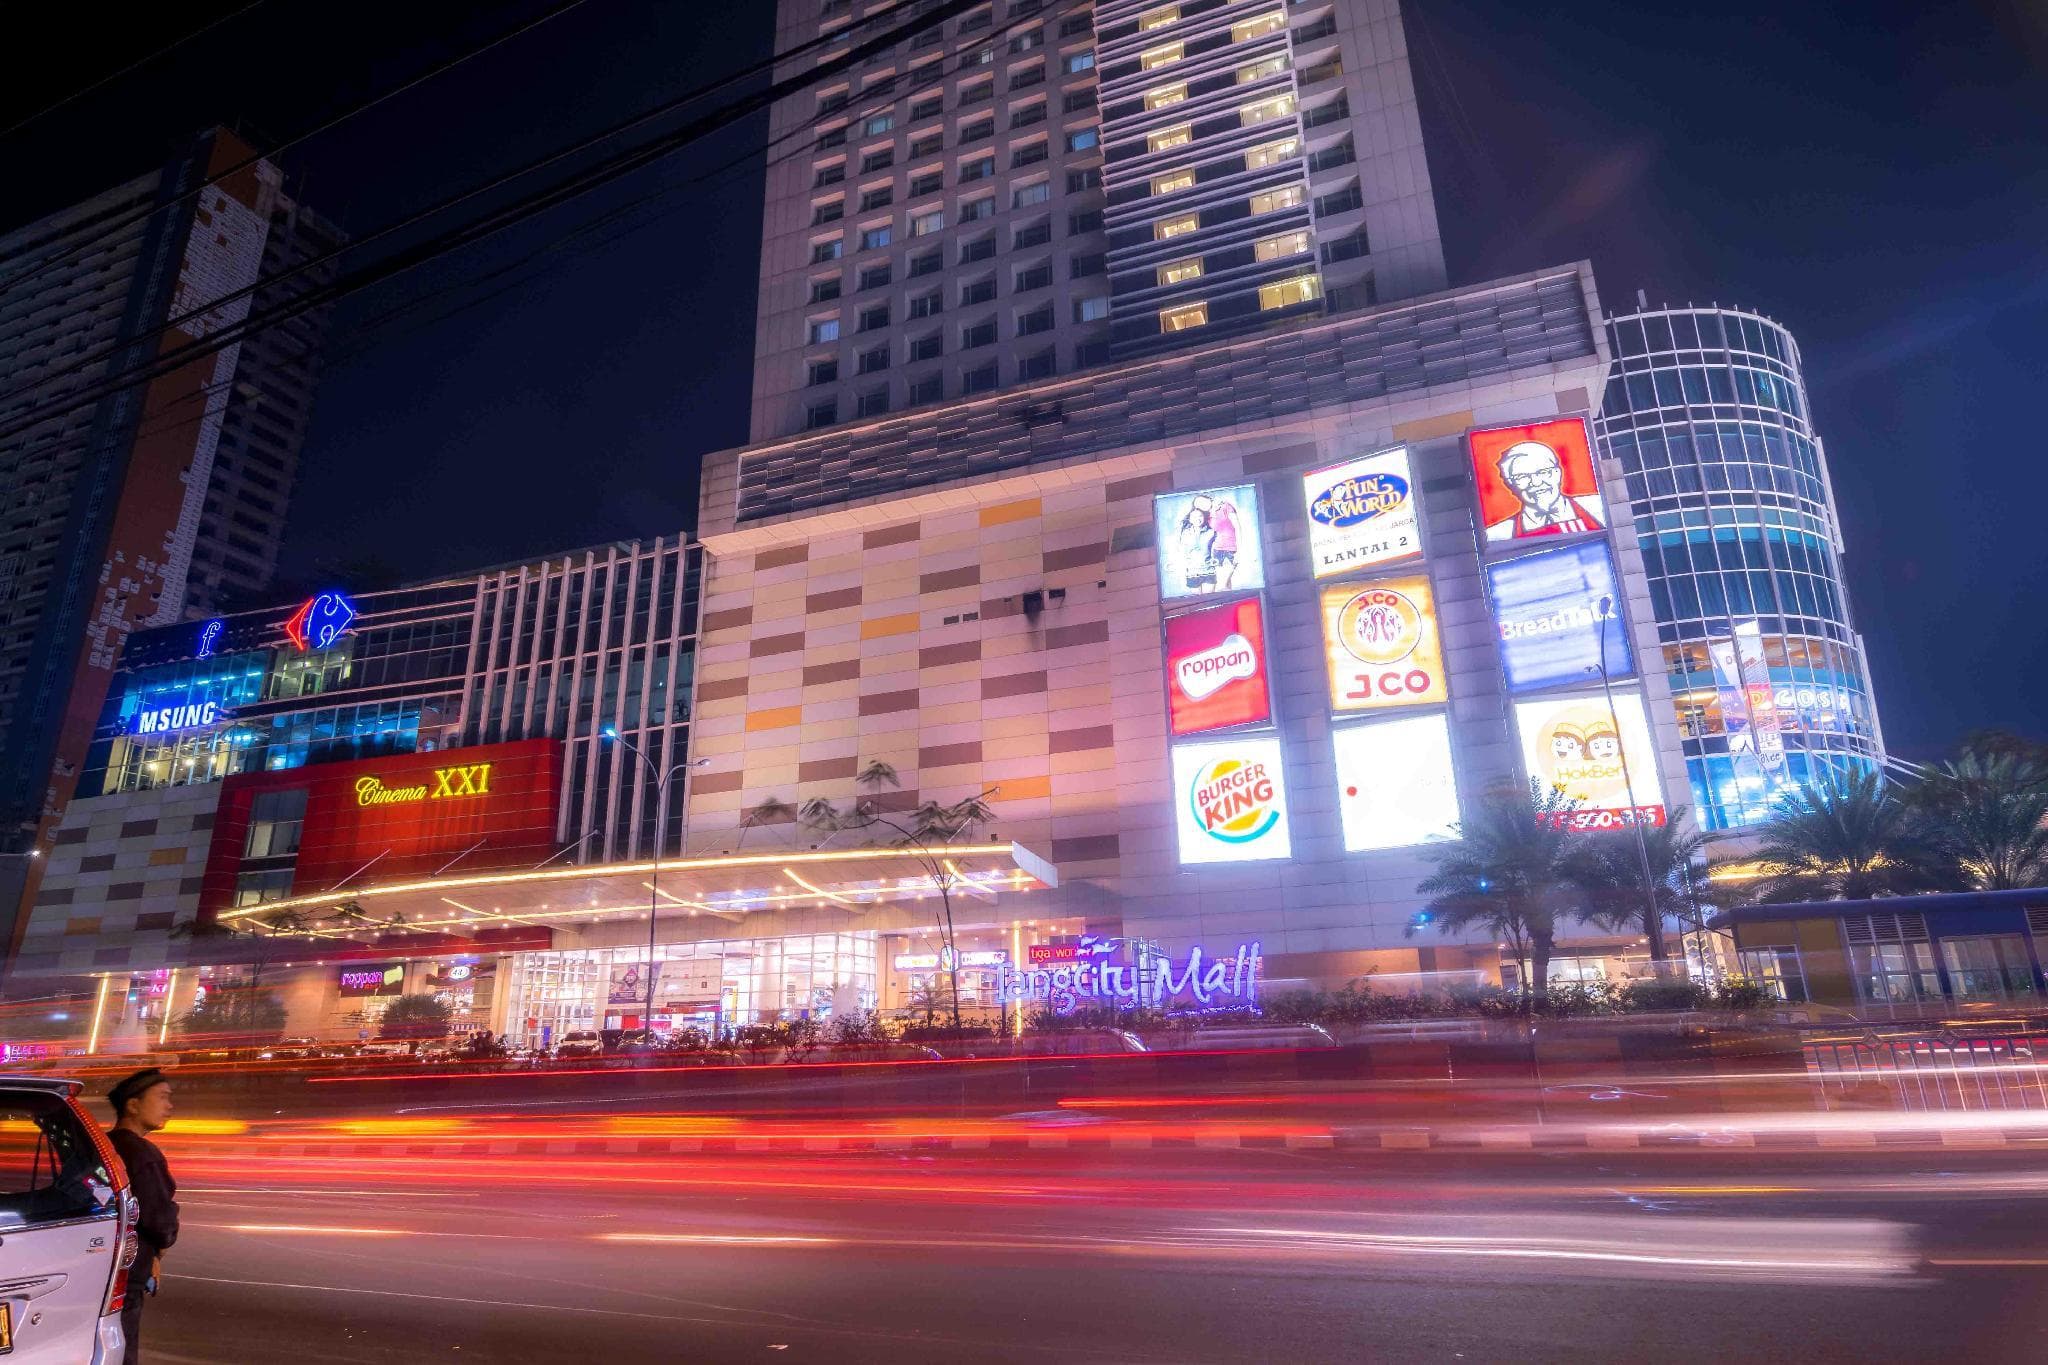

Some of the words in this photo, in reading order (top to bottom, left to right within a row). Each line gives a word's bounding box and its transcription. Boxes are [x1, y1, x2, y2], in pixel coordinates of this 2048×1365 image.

[1341, 490, 1402, 517] WORLD
[1344, 478, 1379, 501] FUN
[1324, 541, 1389, 565] LANTAI
[1399, 536, 1408, 547] 2
[1182, 650, 1250, 677] roppan
[1346, 669, 1430, 699] J.CO
[356, 776, 428, 806] Cinema
[431, 764, 491, 798] XXI
[1198, 763, 1266, 807] BURGER
[1204, 779, 1273, 830] KING
[1031, 948, 1050, 962] tiga
[1151, 941, 1261, 1004] Mall
